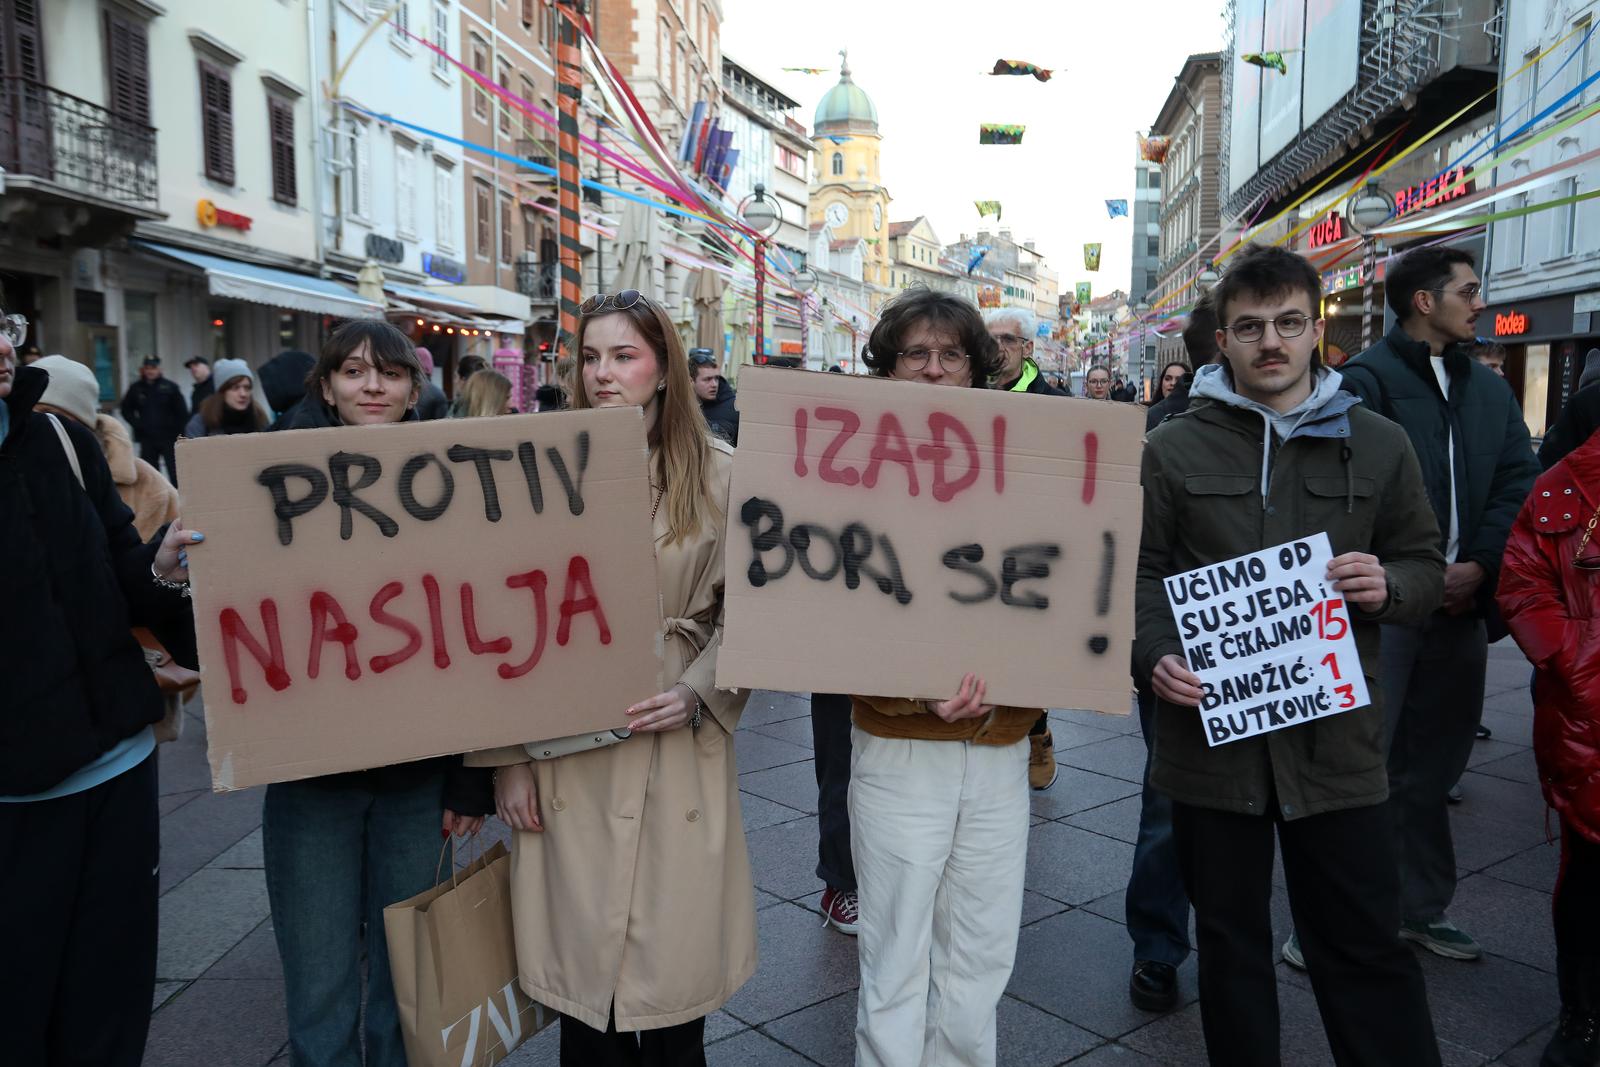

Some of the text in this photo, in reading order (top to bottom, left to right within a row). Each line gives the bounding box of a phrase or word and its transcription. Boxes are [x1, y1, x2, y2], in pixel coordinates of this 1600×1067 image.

[1395, 165, 1466, 218] RIJEKA
[1495, 310, 1526, 336] Rodea
[794, 406, 1007, 502] IZAĐI
[256, 430, 590, 546] PROTIV
[740, 496, 912, 605] BORI
[942, 543, 1060, 610] SE
[1168, 541, 1312, 606] UČIMO OD
[219, 555, 612, 705] NASILJA
[1181, 579, 1328, 640] SUSJEDA i
[1188, 598, 1348, 672] NE ČEKAJMO 15
[1200, 652, 1342, 712] BANOŽIĆ: 1
[1207, 683, 1356, 743] BUTKOVIĆ: 3
